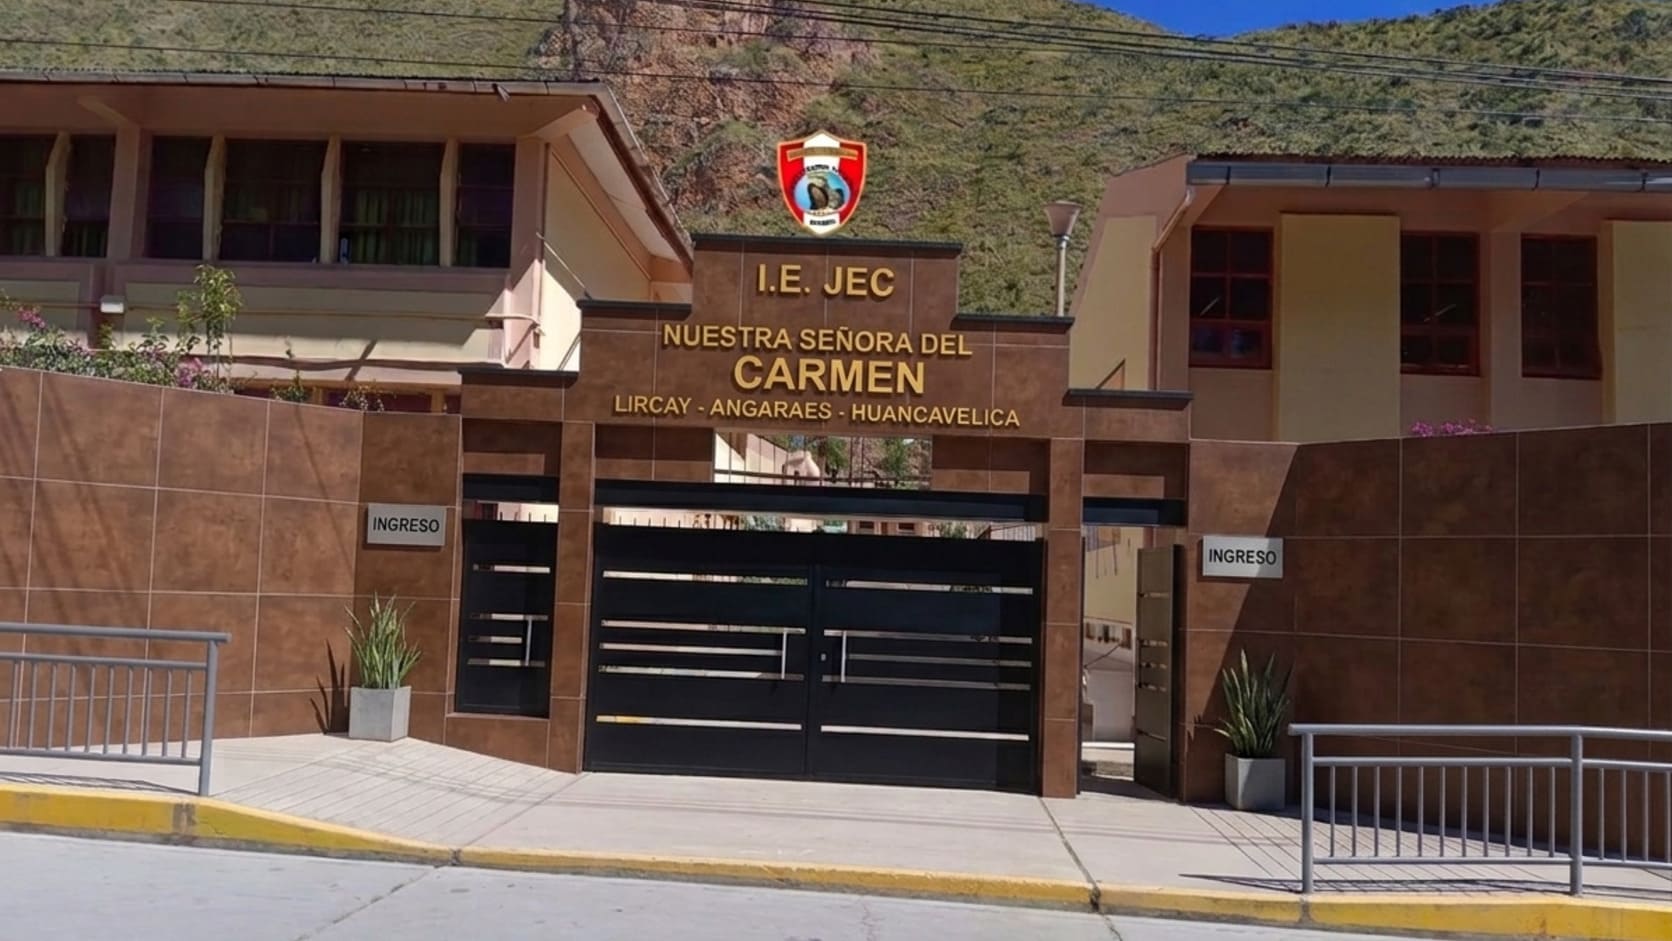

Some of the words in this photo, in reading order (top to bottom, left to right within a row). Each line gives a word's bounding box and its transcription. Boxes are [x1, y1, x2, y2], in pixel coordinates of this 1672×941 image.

[757, 263, 811, 293] I.E.
[824, 265, 895, 297] JEC
[663, 323, 792, 351] NUESTRA
[799, 325, 914, 355] SEÑORA
[920, 333, 972, 356] DEL
[733, 354, 925, 395] CARMEN
[614, 394, 691, 415] LIRCAY
[709, 399, 832, 420] ANGARAES
[851, 404, 1020, 428] HUANCAVELICA
[373, 516, 440, 533] INGRESO
[1208, 548, 1277, 565] INGRESO
